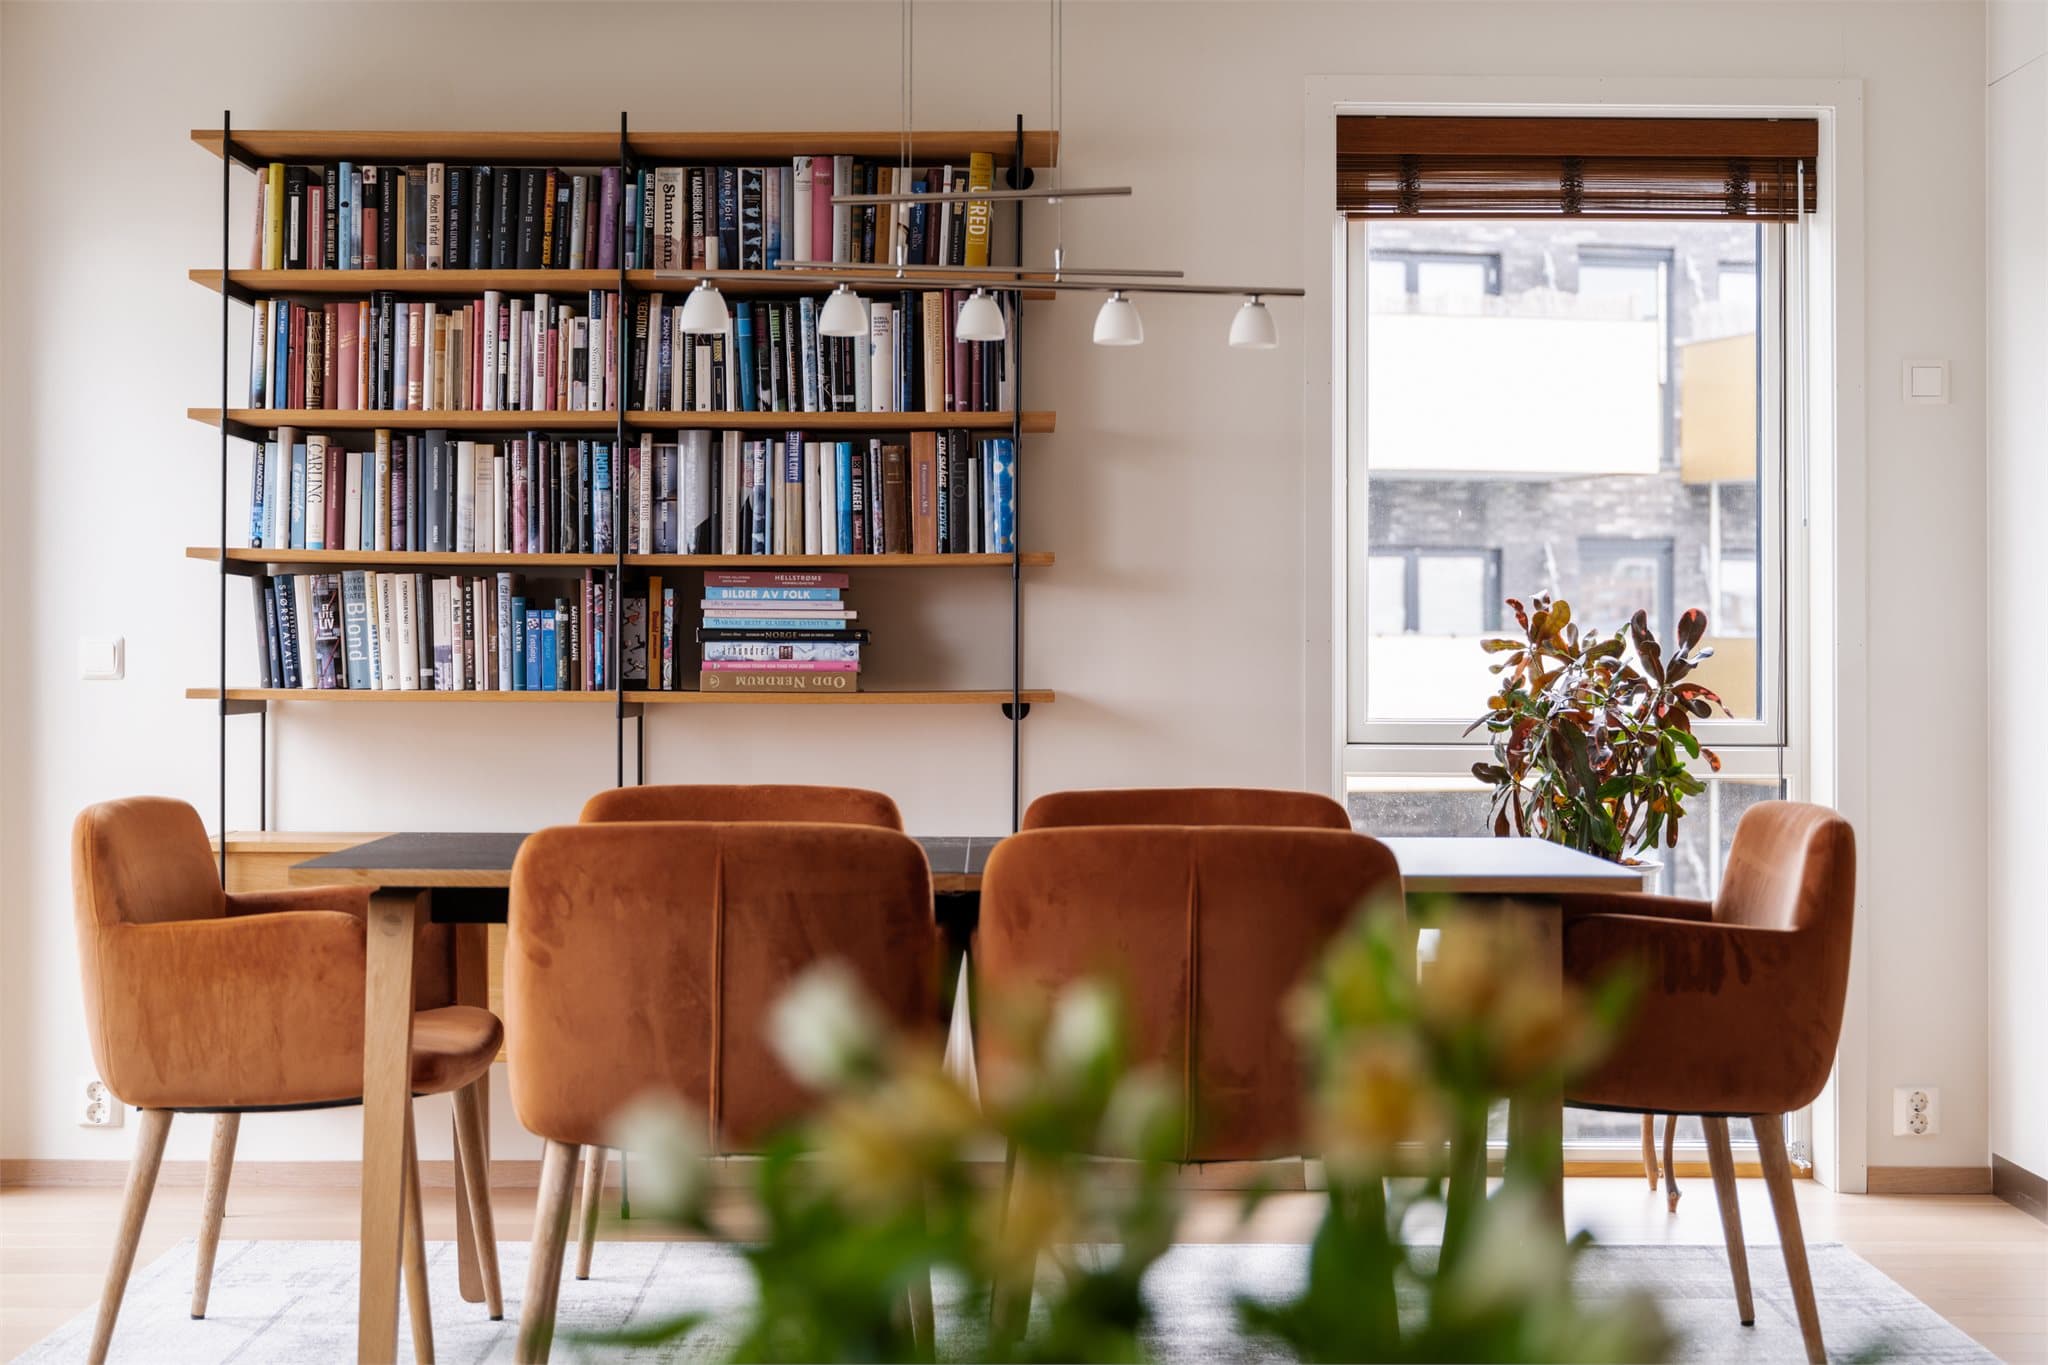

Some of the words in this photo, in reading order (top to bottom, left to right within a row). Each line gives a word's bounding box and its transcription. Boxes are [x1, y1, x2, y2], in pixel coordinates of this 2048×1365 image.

[646, 174, 654, 190] GEIR
[724, 170, 733, 196] Anne
[430, 194, 441, 214] Reisen
[645, 191, 654, 228] LIPPESTAD
[724, 199, 733, 221] Holt
[430, 225, 441, 235] vår
[663, 184, 675, 269] Shantaram
[430, 236, 441, 247] tid
[663, 316, 671, 340] JOHAN
[537, 334, 545, 352] MARTIN
[591, 346, 601, 392] Storytelling
[257, 445, 265, 465] CLARE
[789, 432, 799, 456] STEPHEN
[939, 436, 947, 455] KIM
[307, 444, 323, 503] CARLING
[596, 446, 608, 490] LINDELL
[641, 450, 650, 493] NEGOTIATION
[789, 463, 799, 481] COVEY
[939, 455, 948, 487] SMÅGE
[256, 465, 264, 504] MACKINTOSH
[952, 462, 966, 498] uro
[641, 494, 650, 521] GENIUS
[939, 490, 947, 540] NATTDYKK
[722, 589, 758, 599] BILDER
[763, 590, 779, 599] AV
[783, 590, 811, 599] FOLK
[278, 585, 289, 627] STØRST
[319, 619, 334, 629] LIV
[346, 602, 367, 661] Blond
[765, 631, 797, 639] NORGE
[283, 632, 290, 646] AV
[285, 651, 293, 671] ALT
[735, 675, 806, 689] NERDRUM
[812, 676, 846, 689] ODD
